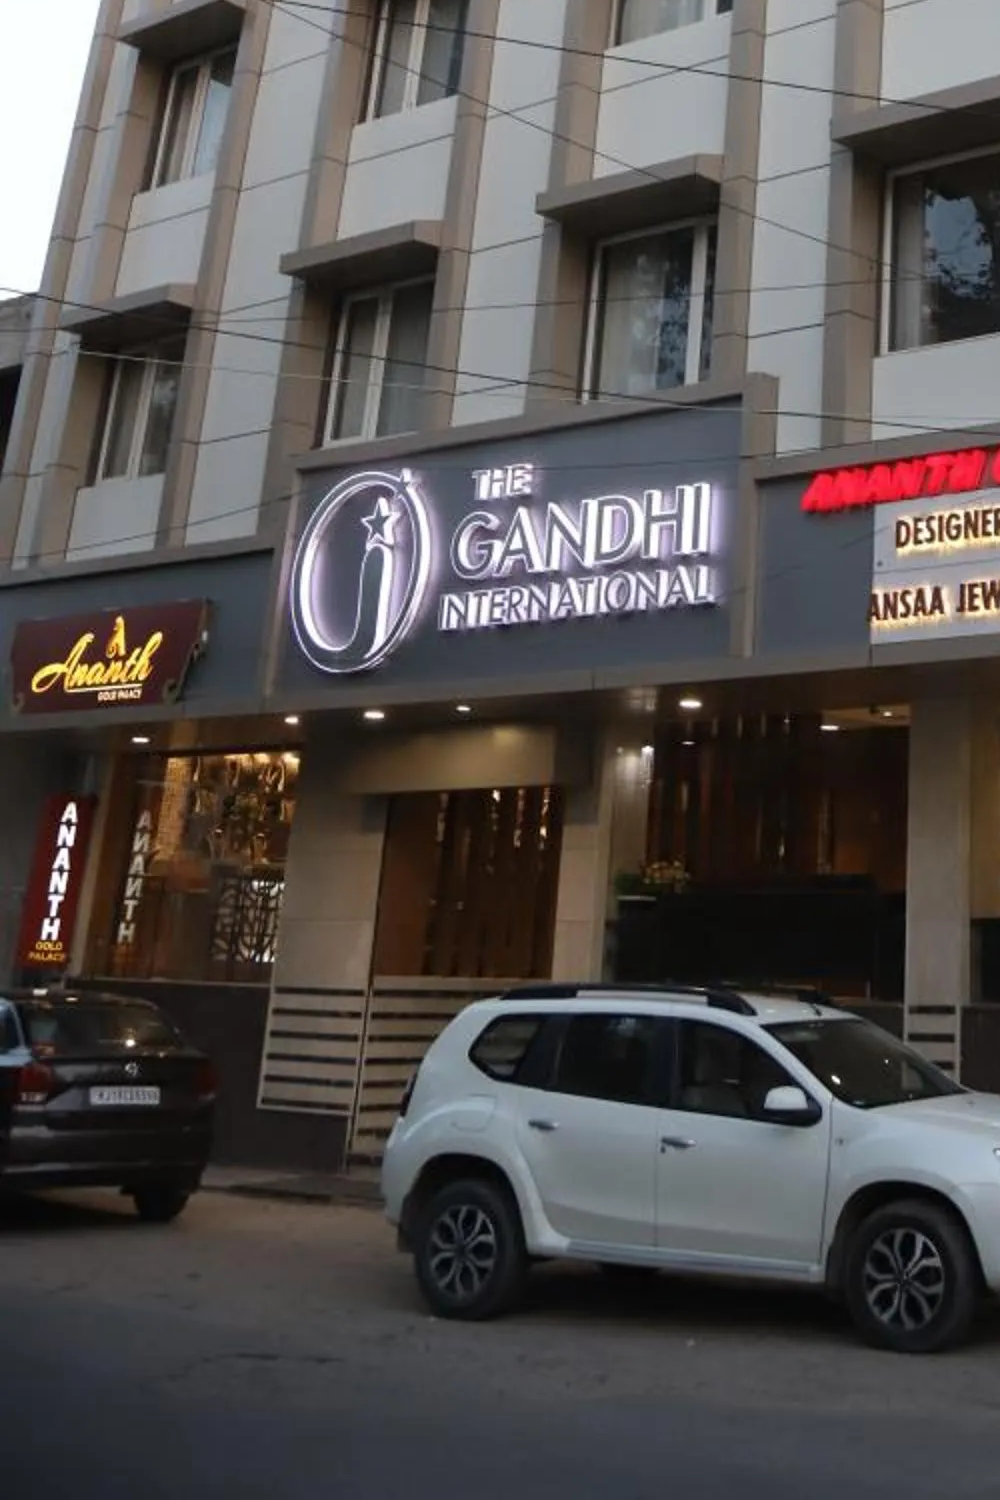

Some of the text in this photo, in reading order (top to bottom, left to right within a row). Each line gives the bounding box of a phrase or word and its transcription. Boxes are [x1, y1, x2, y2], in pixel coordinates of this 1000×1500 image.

[472, 463, 534, 500] THE
[801, 450, 985, 512] ANANTH
[450, 482, 712, 580] GANDHI
[438, 563, 717, 631] INTERNATIONAL
[868, 586, 945, 622] ANSAA
[31, 631, 163, 693] Ananth
[40, 802, 78, 941] ANANTH
[35, 941, 63, 951] GOLD
